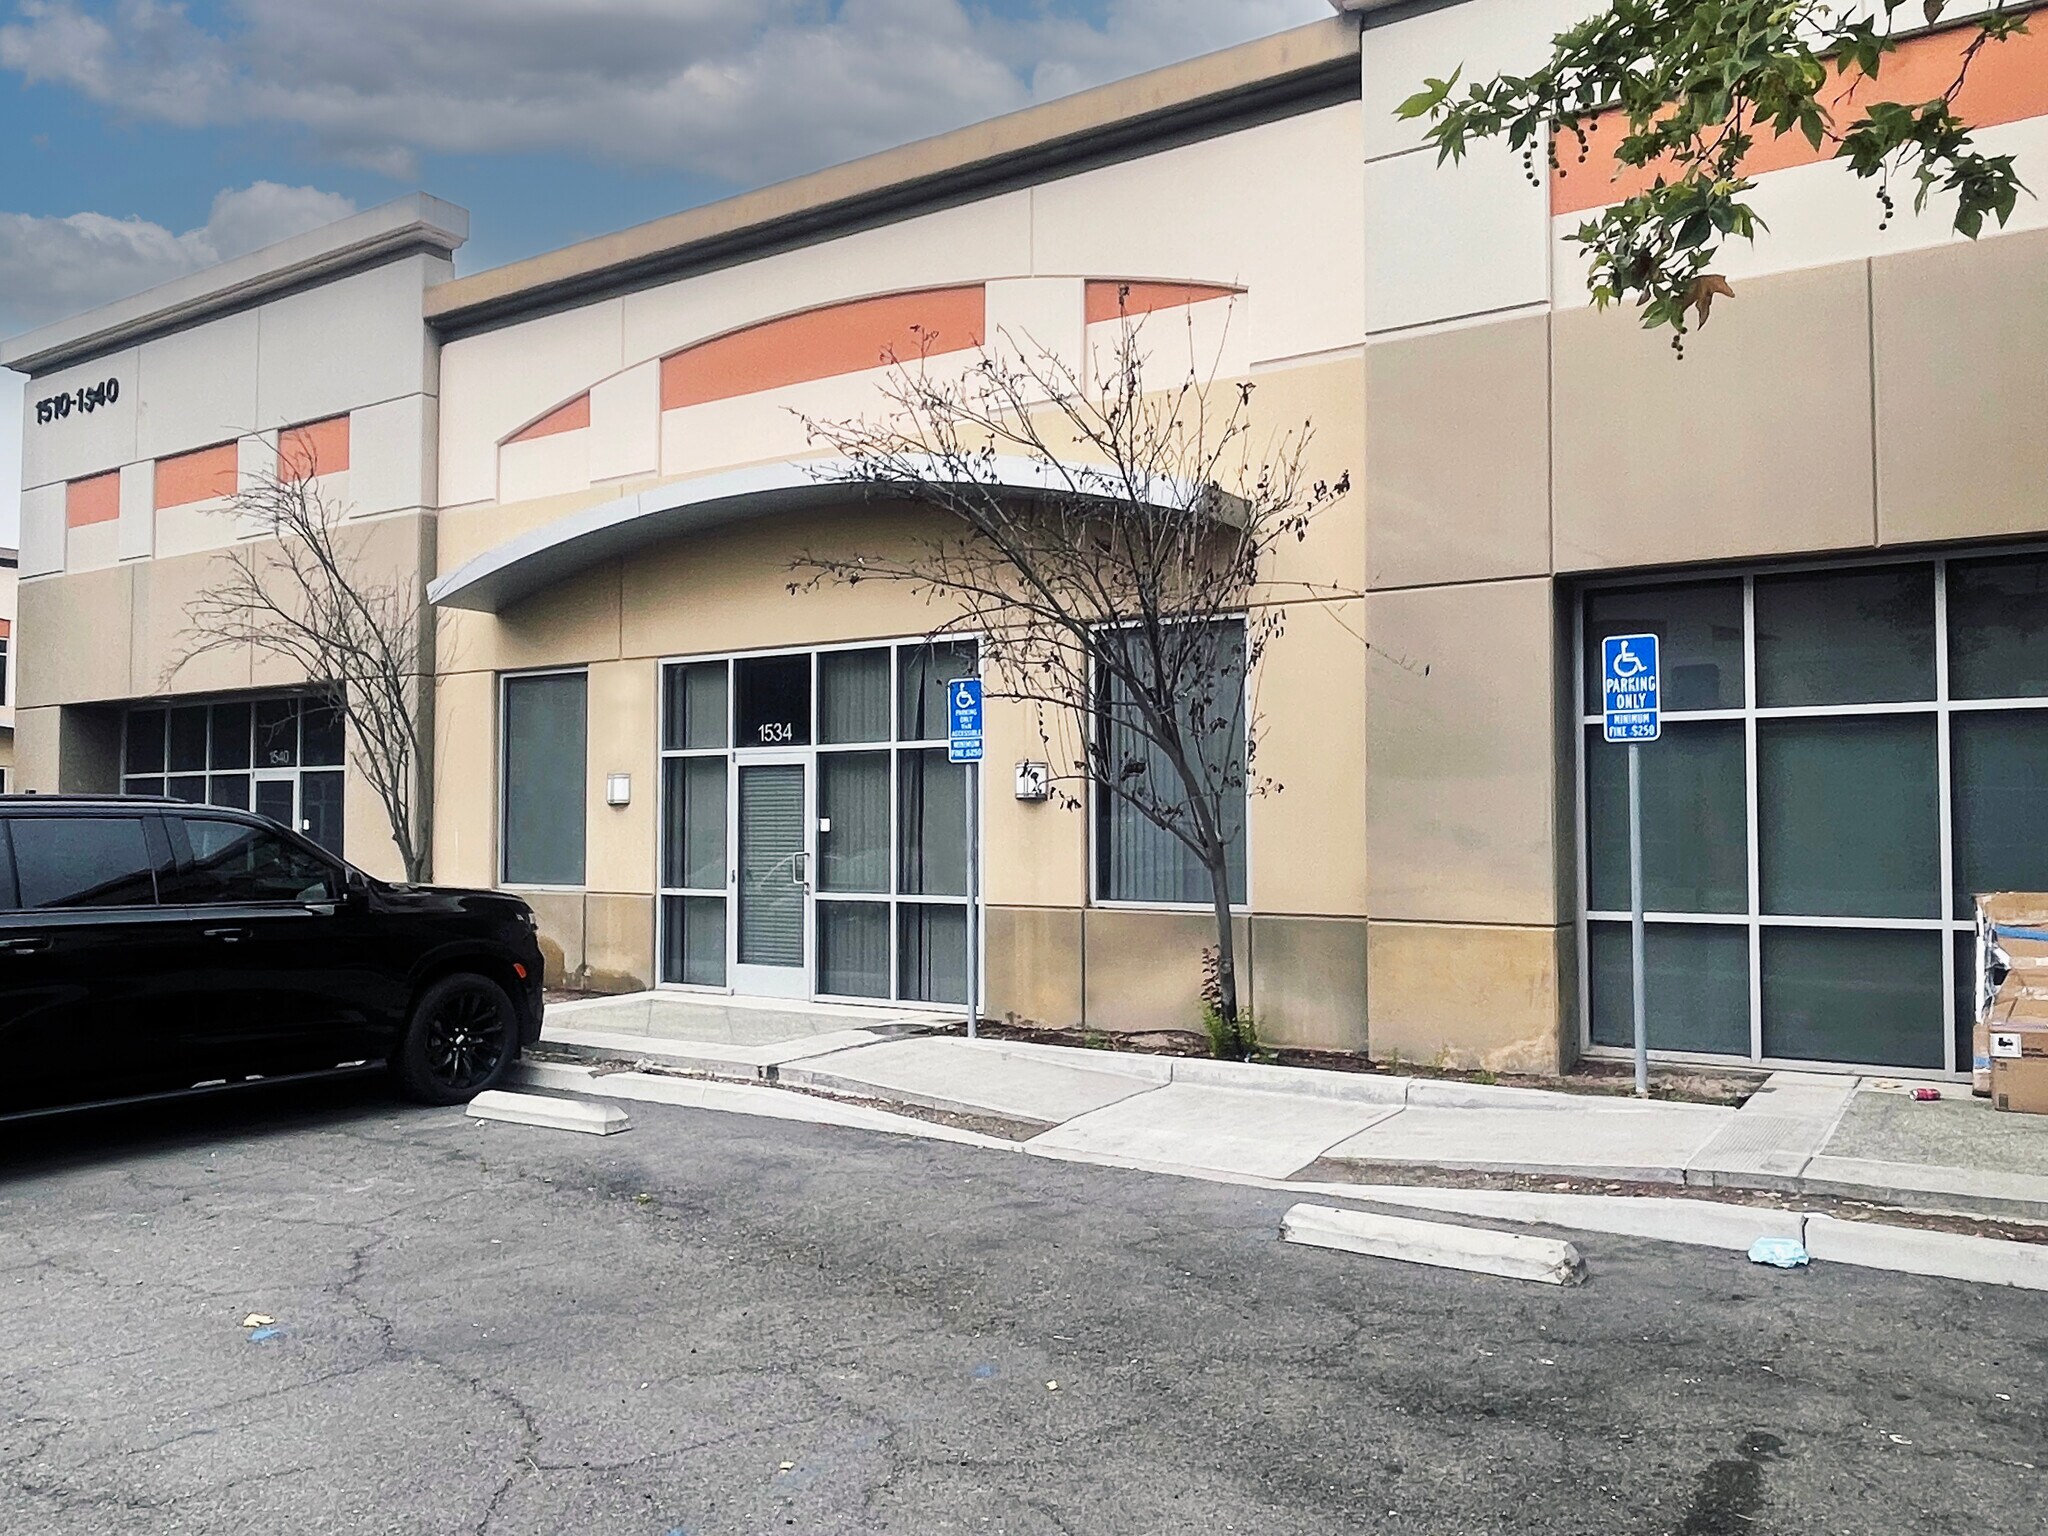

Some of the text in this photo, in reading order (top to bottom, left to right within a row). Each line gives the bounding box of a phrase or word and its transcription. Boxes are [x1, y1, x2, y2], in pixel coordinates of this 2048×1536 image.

[35, 377, 119, 425] 1510-1540
[1606, 676, 1656, 693] PARKING
[1616, 692, 1647, 709] ONLY
[955, 708, 977, 717] PARKING
[959, 715, 974, 723] ONLY
[1613, 713, 1650, 724] MINIMUM
[758, 722, 792, 741] 1534
[1609, 724, 1655, 737] FINE $250
